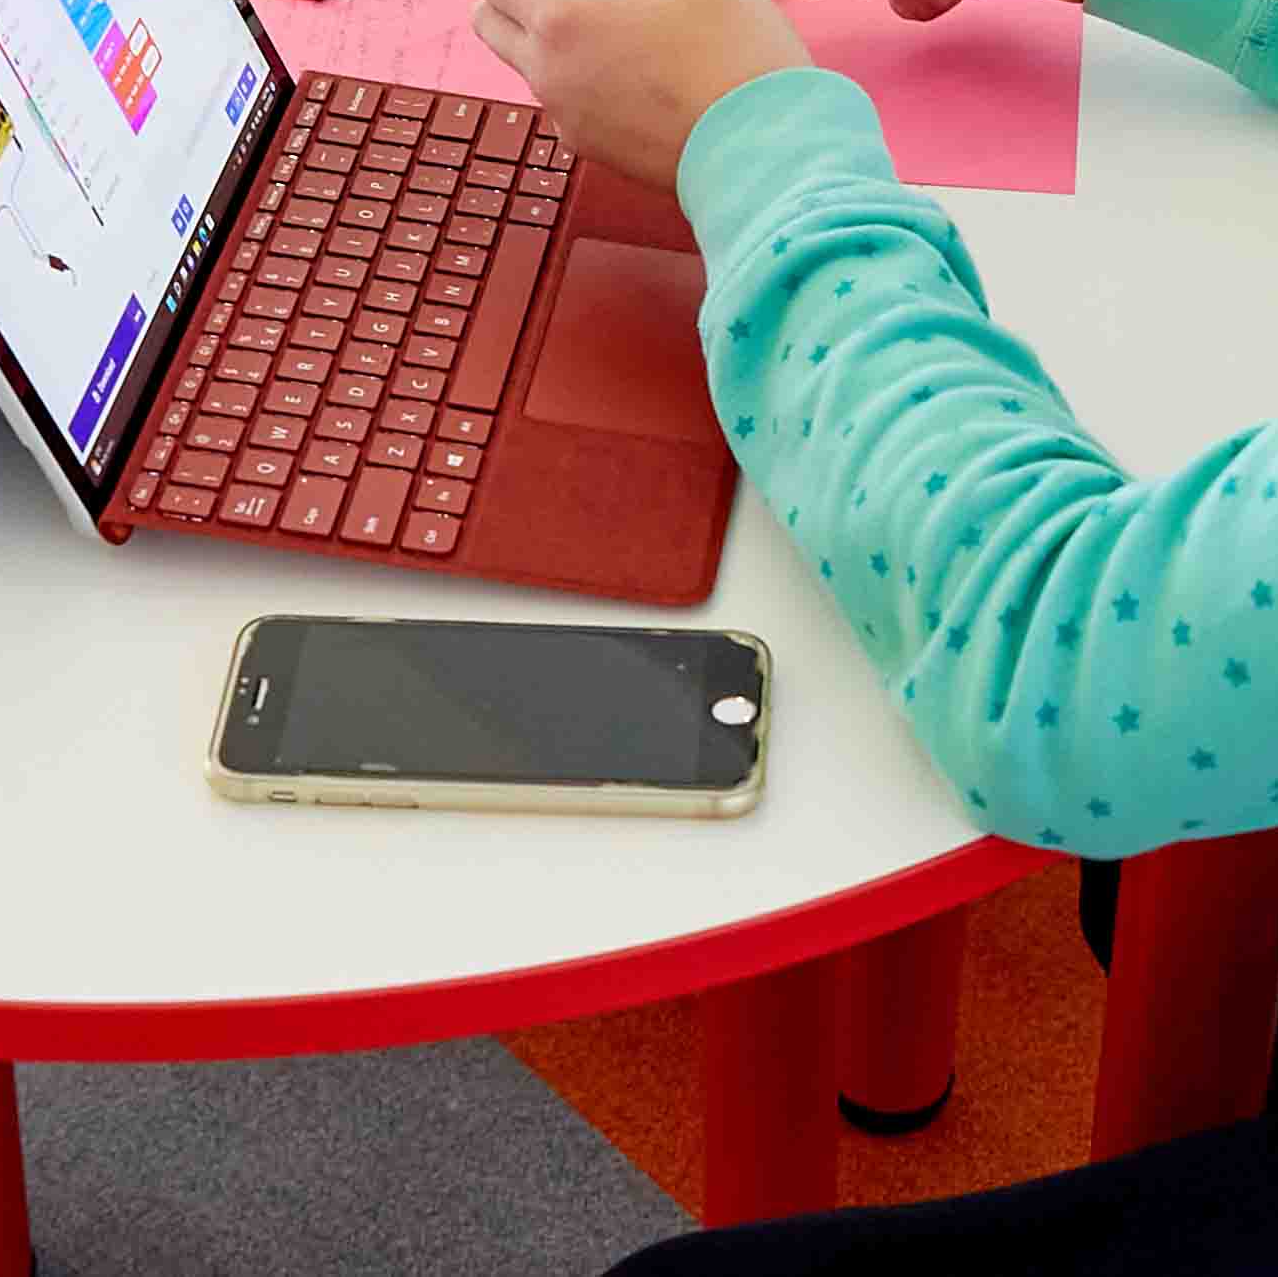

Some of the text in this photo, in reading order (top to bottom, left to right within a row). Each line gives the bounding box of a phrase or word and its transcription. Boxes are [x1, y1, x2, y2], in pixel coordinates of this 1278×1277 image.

[256, 462, 276, 474] Q
[270, 425, 290, 439] W
[284, 394, 302, 405] E
[296, 361, 316, 371] R
[322, 297, 340, 309] Y
[335, 268, 351, 278] U
[358, 209, 374, 219] O
[323, 453, 340, 465] A
[335, 419, 354, 431] S
[348, 386, 365, 397] D
[372, 322, 390, 333] G
[385, 291, 402, 303] H
[386, 445, 406, 458] Z
[400, 411, 419, 423] X
[411, 379, 429, 391] C
[422, 347, 439, 358] V
[454, 254, 470, 267] M
